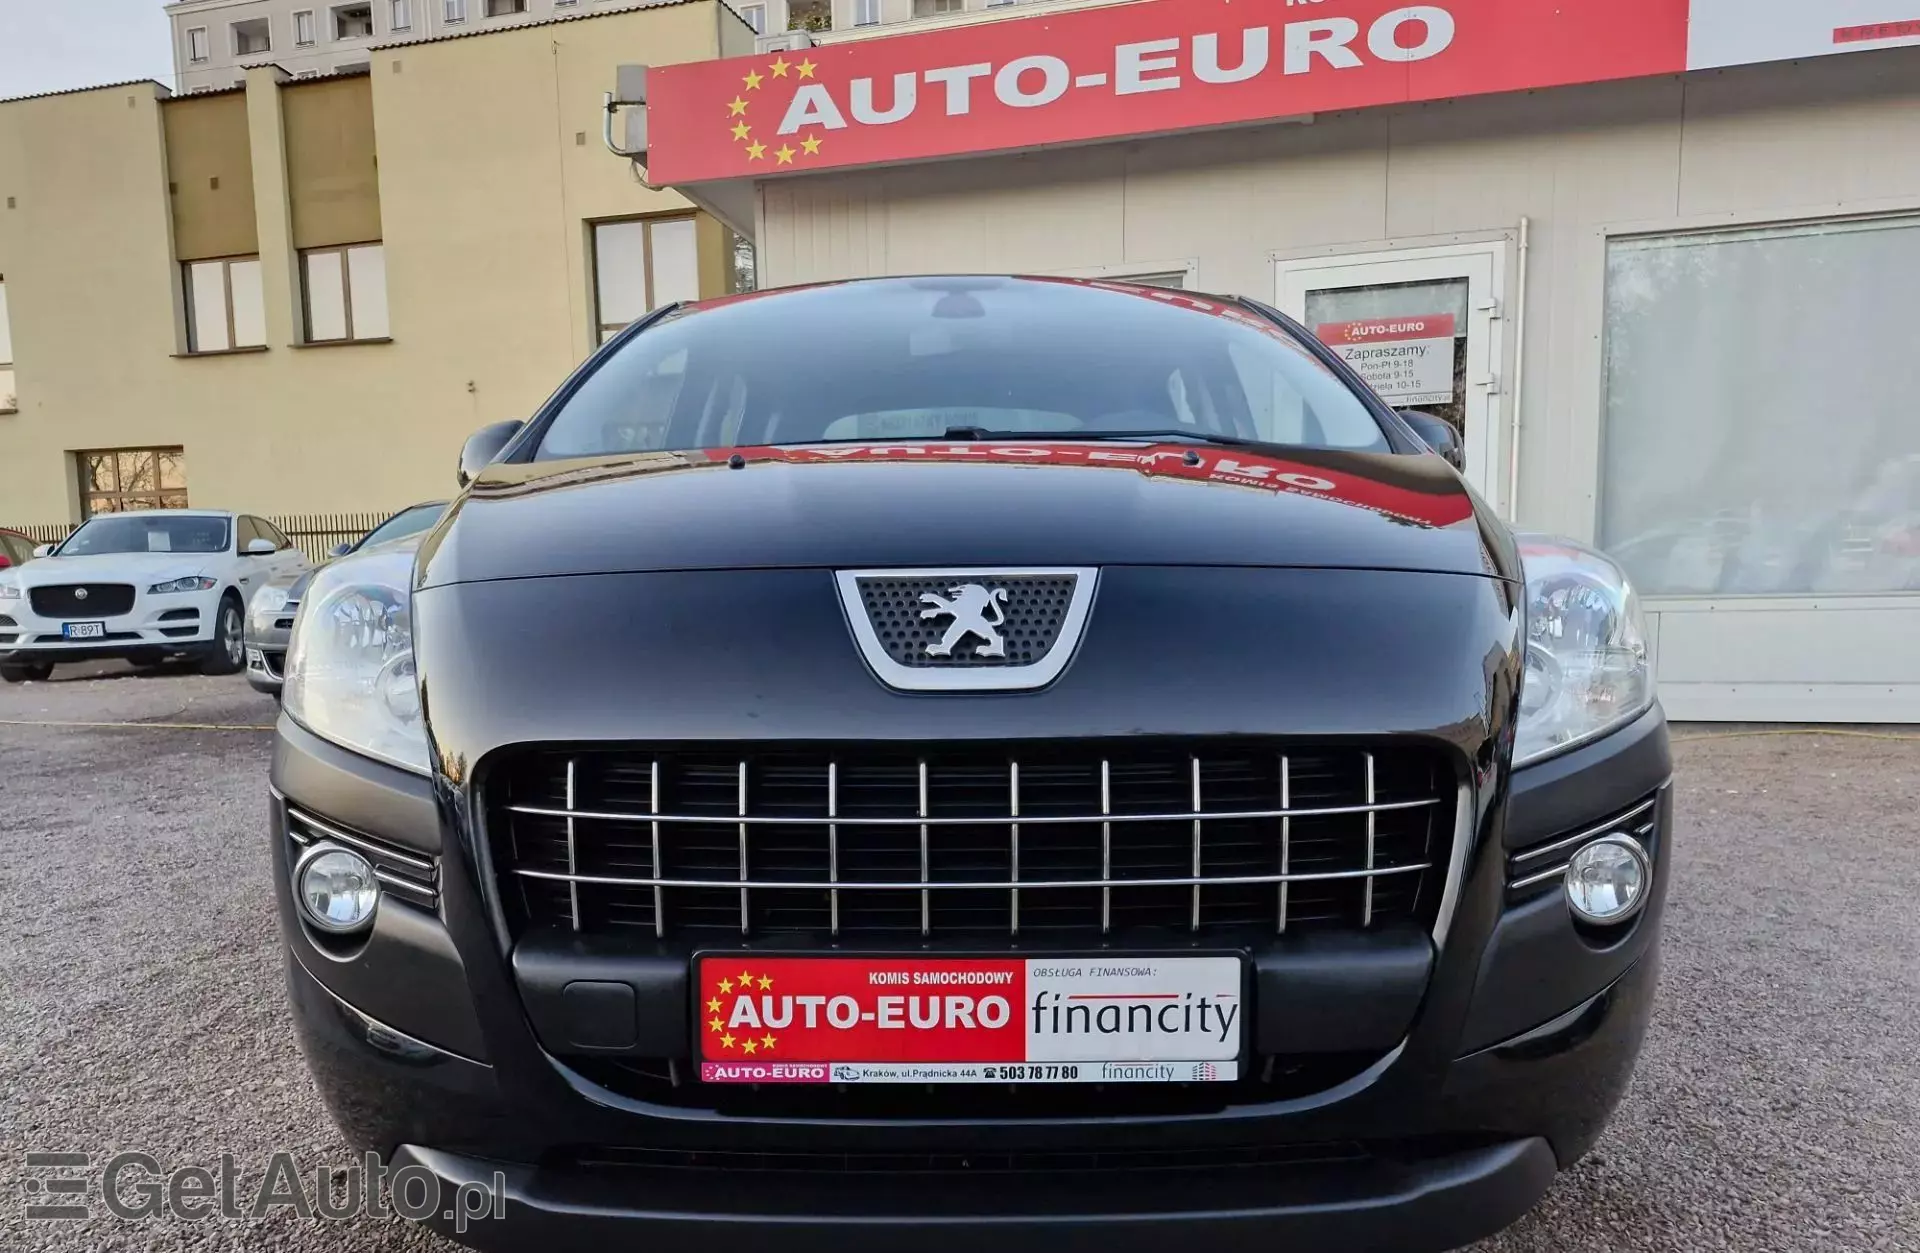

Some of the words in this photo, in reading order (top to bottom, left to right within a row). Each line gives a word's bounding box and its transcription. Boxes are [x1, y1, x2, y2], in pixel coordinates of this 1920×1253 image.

[776, 5, 1455, 136] AUTO-EURO
[1351, 321, 1424, 336] AUTO-EURO
[869, 972, 909, 985] KOMIS
[913, 972, 1014, 985] SAMOCHODOWY
[1033, 967, 1083, 978] OBSŁUGA
[728, 995, 1010, 1029] AUTO-EURO
[1032, 990, 1238, 1043] financity
[714, 1067, 825, 1079] AUTO-EURO
[862, 1069, 900, 1079] Kraków,
[959, 1068, 978, 1078] 44A
[1000, 1066, 1025, 1080] 503
[1028, 1066, 1043, 1080] 78
[1046, 1066, 1059, 1080] 77
[1061, 1066, 1078, 1080] 80
[1102, 1062, 1174, 1081] financity
